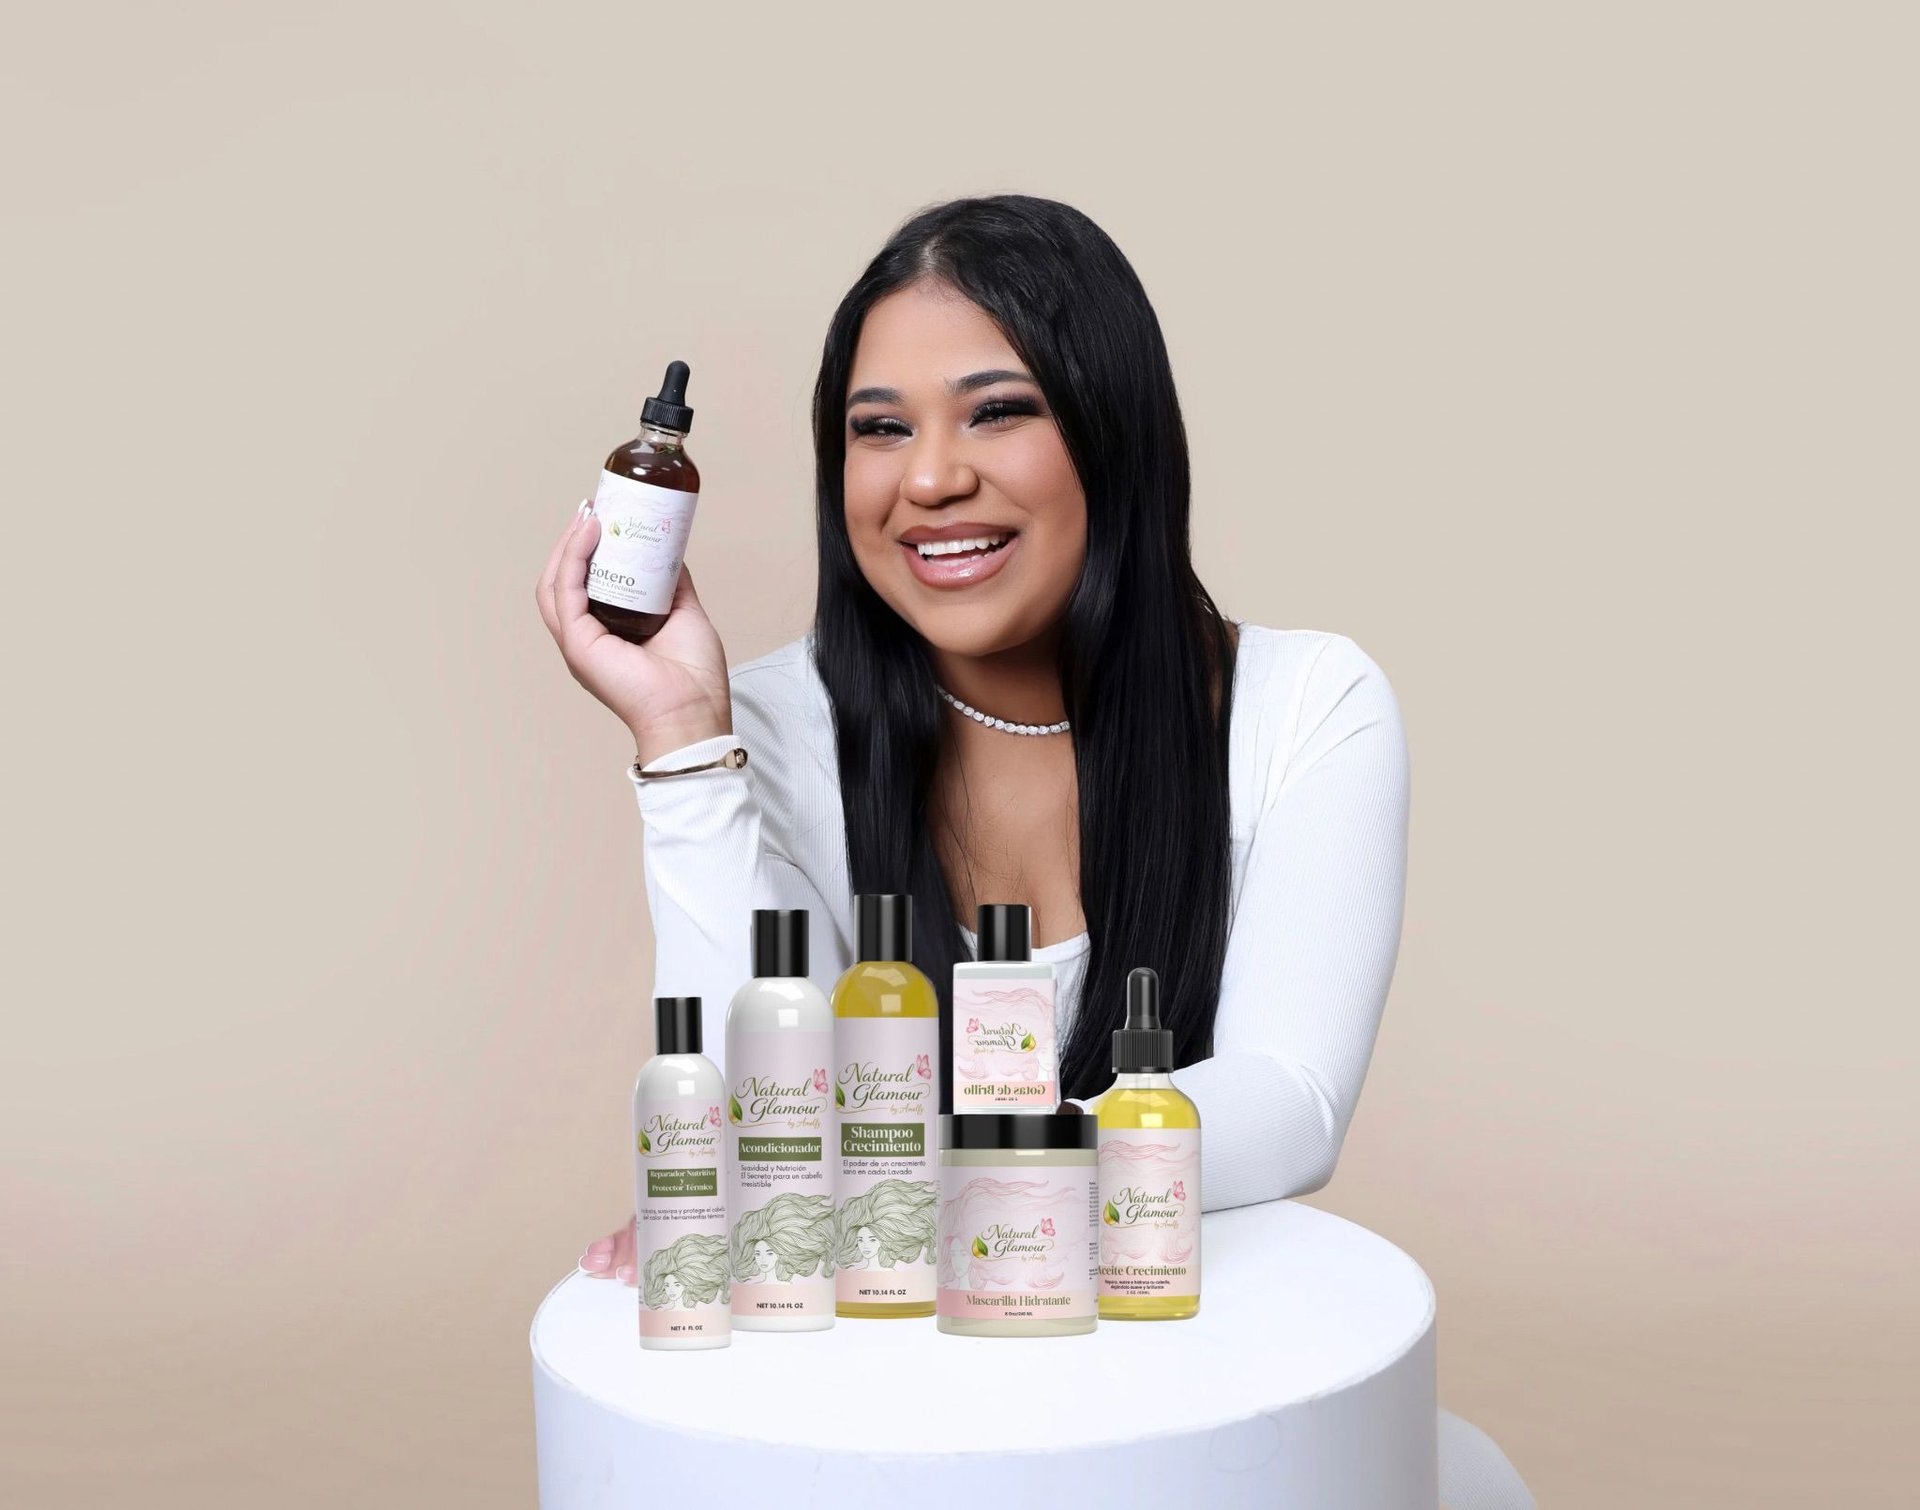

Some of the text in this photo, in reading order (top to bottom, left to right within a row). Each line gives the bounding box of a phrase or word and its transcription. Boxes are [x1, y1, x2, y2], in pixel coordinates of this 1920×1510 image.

[625, 527, 662, 543] Glamour
[589, 561, 635, 587] Gotero
[838, 1062, 915, 1085] Natural
[735, 1075, 812, 1099] Natural
[851, 1083, 923, 1109] Glamour
[749, 1097, 821, 1124] Glamour
[643, 1113, 708, 1134] Natural
[851, 1126, 914, 1142] Shampoo
[656, 1131, 716, 1154] Glamour
[739, 1142, 821, 1154] Acondicionador
[843, 1140, 921, 1152] Crecimiento
[740, 1164, 807, 1173] Suavidad y Nutrición
[843, 1159, 849, 1167] El
[849, 1159, 869, 1169] poder
[870, 1159, 880, 1167] de
[649, 1169, 716, 1180] Reparador Nutritivo
[746, 1172, 772, 1180] Secreto
[772, 1173, 791, 1181] para
[801, 1171, 823, 1179] cabello
[652, 1184, 685, 1192] Protector
[1112, 1186, 1172, 1206] Natural
[1125, 1204, 1178, 1225] Glamour
[981, 1224, 1039, 1240] Natural
[993, 1239, 1047, 1258] Glamour
[1125, 1265, 1187, 1276] Crecimiento
[966, 1294, 1071, 1307] Mascarilla Hidratante
